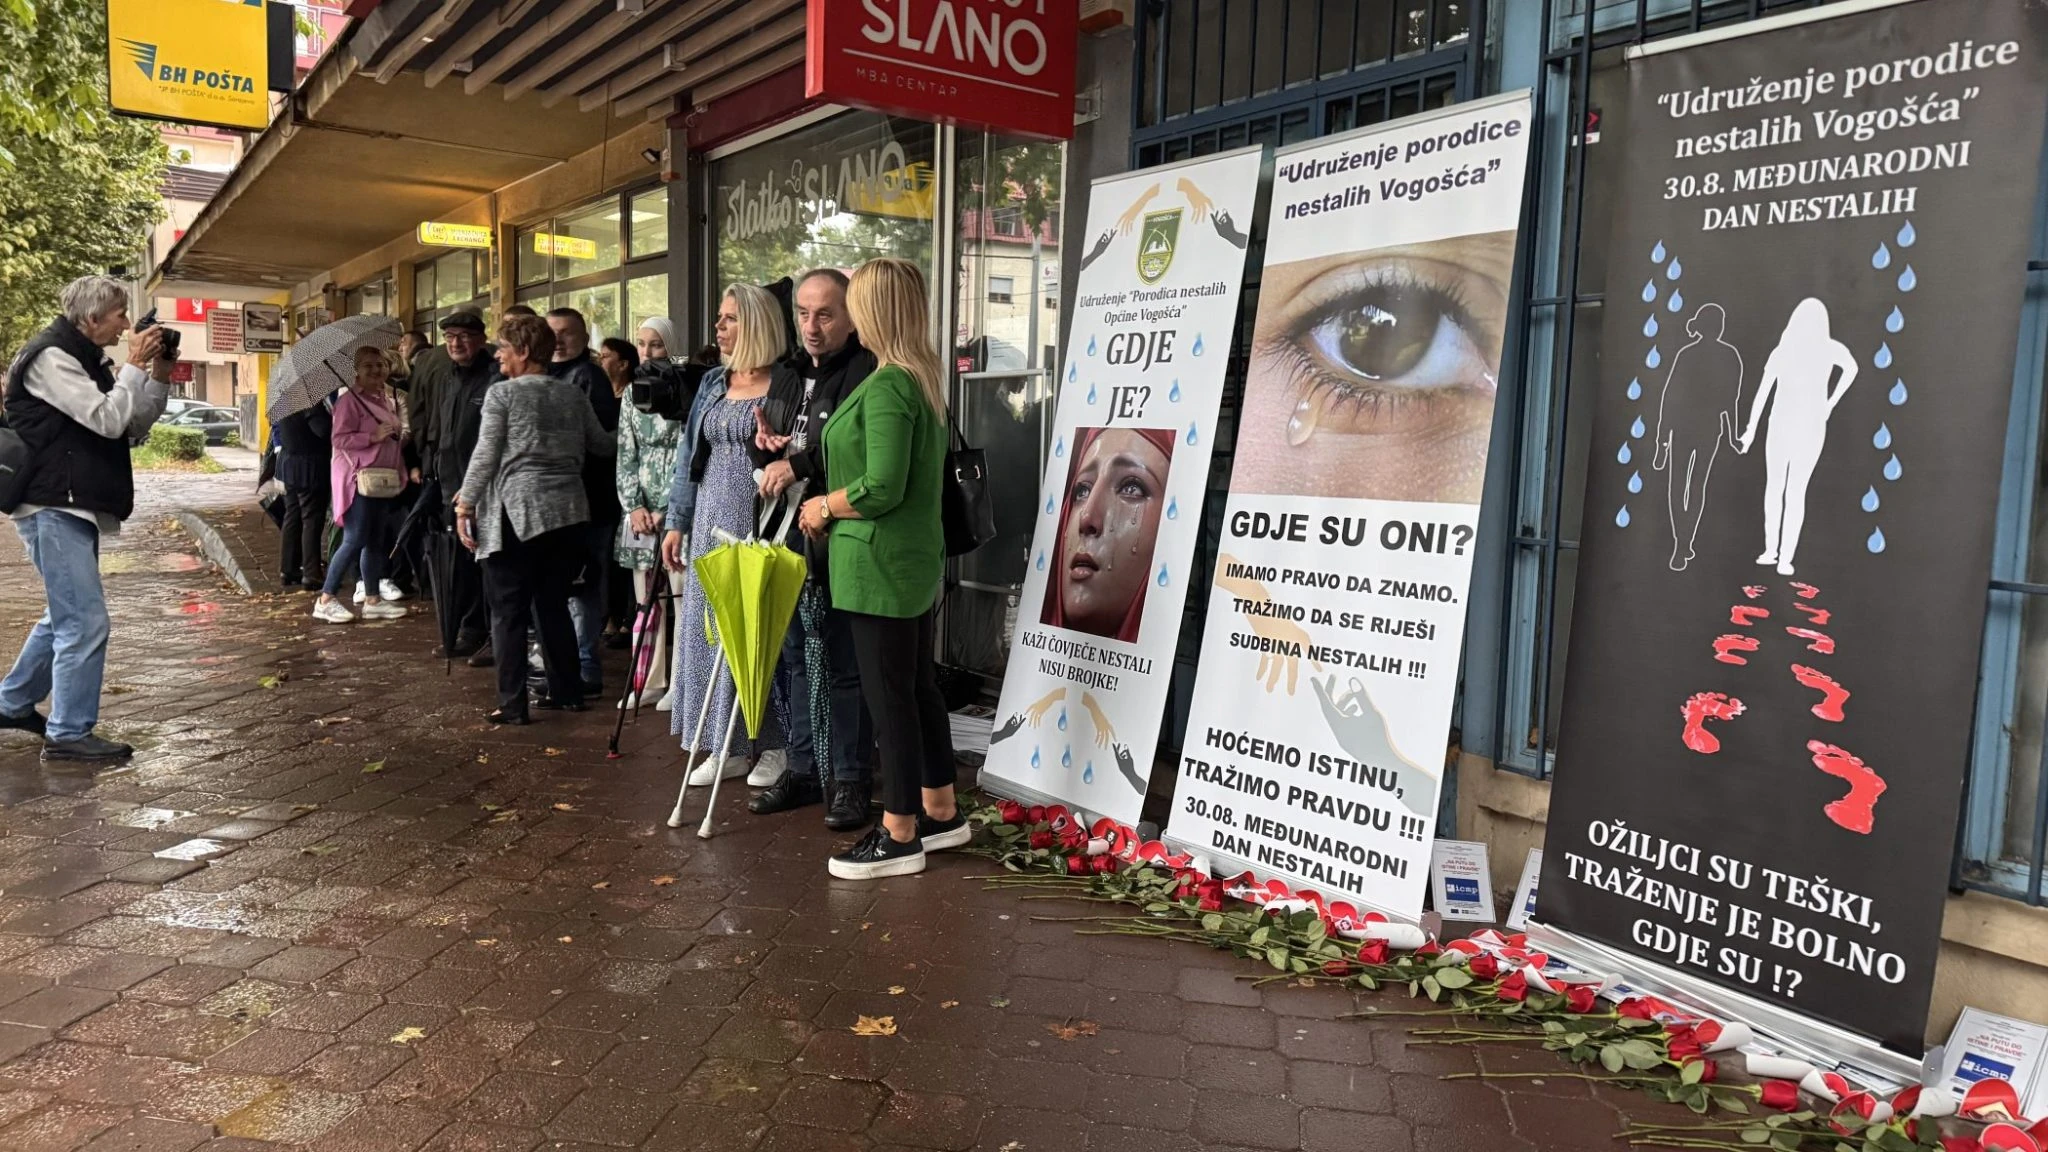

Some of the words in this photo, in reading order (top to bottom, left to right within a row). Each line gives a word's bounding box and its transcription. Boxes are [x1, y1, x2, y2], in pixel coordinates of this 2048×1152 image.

[861, 0, 1047, 76] SLANO
[159, 65, 187, 83] BH
[193, 69, 253, 93] POŠTA
[856, 67, 888, 84] MBA
[896, 75, 958, 96] CENTAR
[1657, 68, 1835, 118] “Udruženje
[1844, 40, 2020, 98] porodice
[1674, 114, 1802, 159] nestalih
[1813, 87, 1980, 142] Vogošća”
[1279, 143, 1398, 184] “Udruženje
[1404, 118, 1522, 163] porodice
[1663, 172, 1726, 200] 30.8.
[1732, 140, 1972, 193] MEĐUNARODNI
[727, 169, 793, 241] Slatko
[804, 141, 906, 224] SLANO
[1284, 184, 1371, 220] nestalih
[1380, 158, 1501, 201] Vogošća”
[1701, 203, 1761, 231] DAN
[1767, 187, 1918, 225] NESTALIH
[1080, 292, 1127, 308] Udruženje
[1180, 281, 1226, 298] nestalih
[1104, 309, 1138, 326] Općine
[1106, 330, 1176, 372] GDJE
[1105, 385, 1151, 426] JE?
[1230, 510, 1309, 542] GDJE
[1319, 516, 1367, 546] SU
[1380, 520, 1474, 556] ONI?
[1226, 563, 1277, 582] IMAMO
[1281, 568, 1341, 590] PRAVO
[1346, 576, 1373, 594] DA
[1378, 579, 1458, 604] ZNAMO.
[1233, 598, 1306, 622] TRAŽIMO
[1310, 608, 1333, 626] DA
[1338, 612, 1365, 631] SE
[1370, 616, 1436, 641] RIJEŠI
[1021, 631, 1047, 650] KAŽI
[1048, 634, 1097, 662] ČOVJEČE
[1098, 649, 1153, 675] NESTALI
[1038, 658, 1066, 678] NISU
[1066, 666, 1119, 692] BROJKE!
[1229, 632, 1302, 658] SUDBINA
[1307, 644, 1402, 675] NESTALIH
[1407, 661, 1427, 679] !!!
[1205, 727, 1301, 768] HOĆEMO
[1308, 752, 1404, 800] ISTINU,
[1184, 757, 1280, 801] TRAŽIMO
[1286, 785, 1391, 832] PRAVDU
[1399, 815, 1425, 842] !!!
[1185, 796, 1238, 827] 30.08.
[1244, 813, 1409, 880] MEĐUNARODNI
[1212, 830, 1252, 858] DAN
[1257, 843, 1364, 894] NESTALIH
[1588, 818, 1702, 876] OŽILJCI
[1707, 855, 1753, 890] SU
[1762, 868, 1882, 935] TEŠKI,
[1455, 884, 1478, 894] icmp
[1564, 852, 1720, 926] TRAŽENJE
[1725, 903, 1762, 940] JE
[1769, 917, 1906, 985] BOLNO
[1632, 918, 1711, 967] GDJE
[1717, 947, 1763, 984] SU
[1772, 965, 1803, 998] !?
[1990, 1037, 2010, 1047] PUTU
